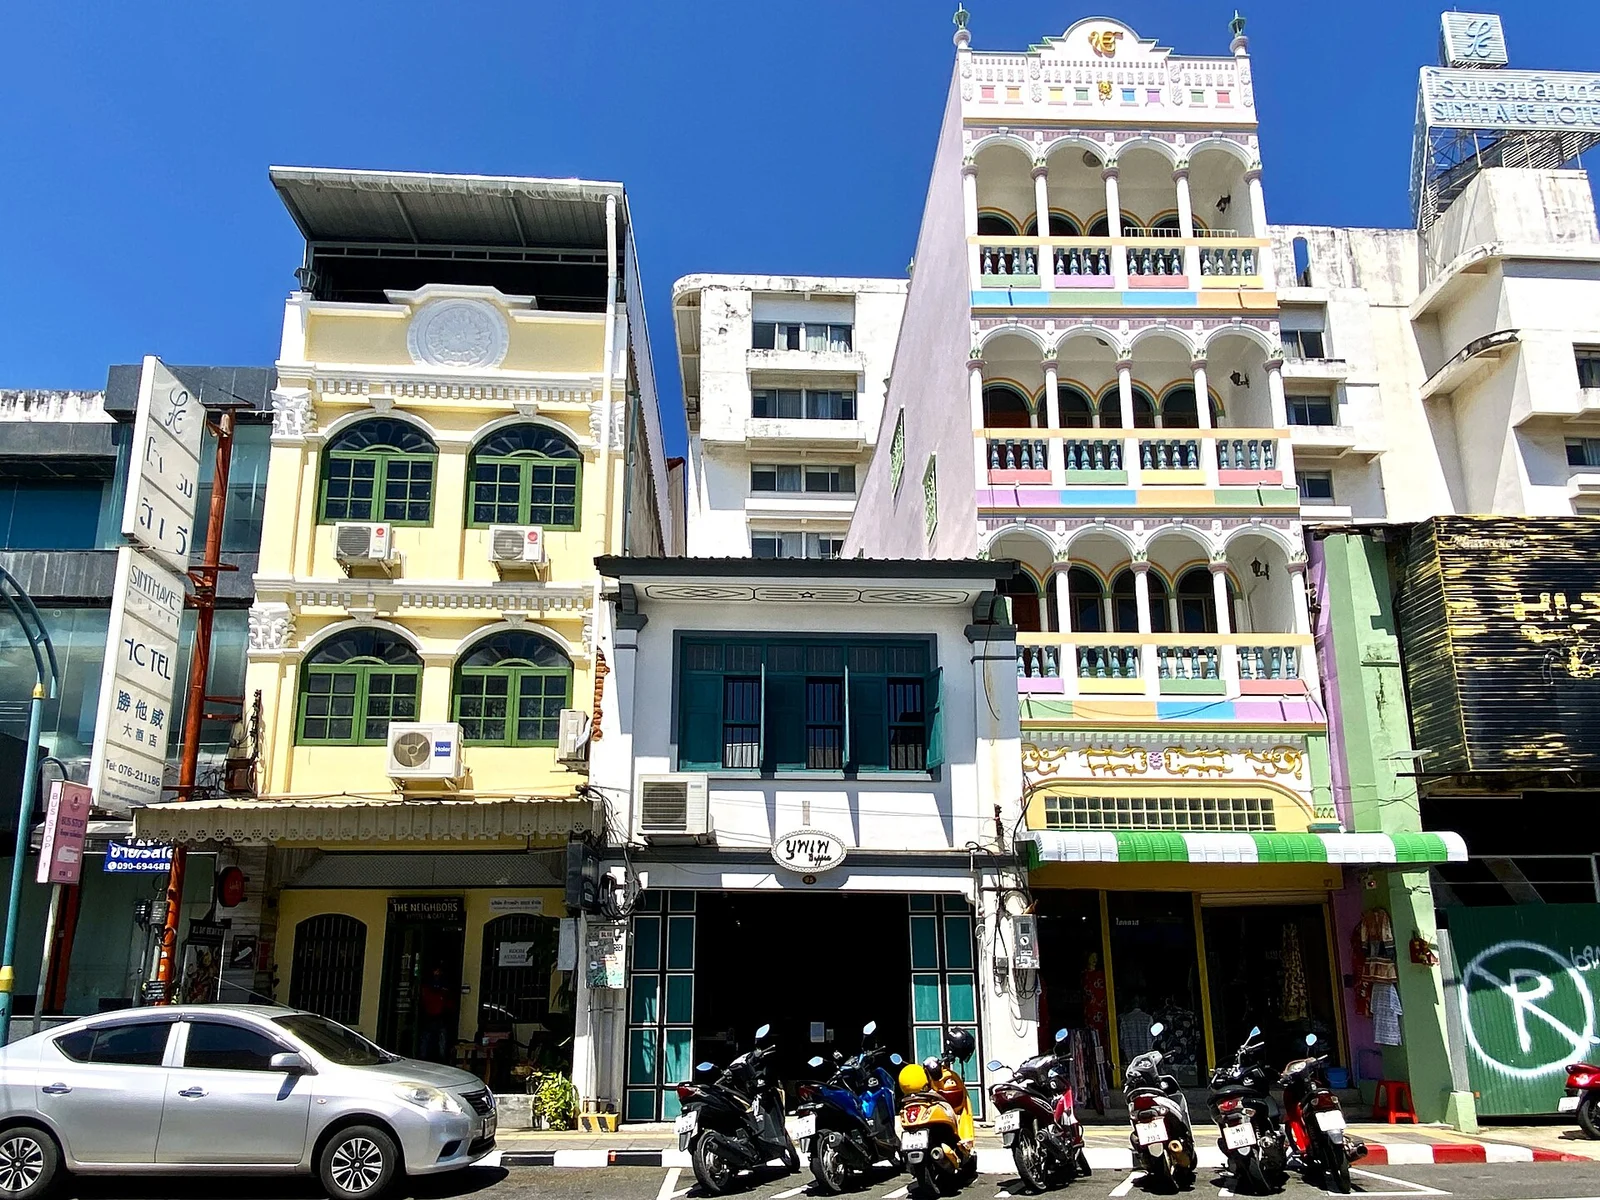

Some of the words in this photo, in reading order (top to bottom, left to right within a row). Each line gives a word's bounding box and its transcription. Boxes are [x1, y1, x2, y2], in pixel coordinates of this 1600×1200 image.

[122, 722, 158, 748] 大酒店
[50, 792, 59, 816] BUS
[44, 822, 55, 850] STOP
[393, 902, 408, 912] THE
[410, 902, 458, 912] NEIGHBORS
